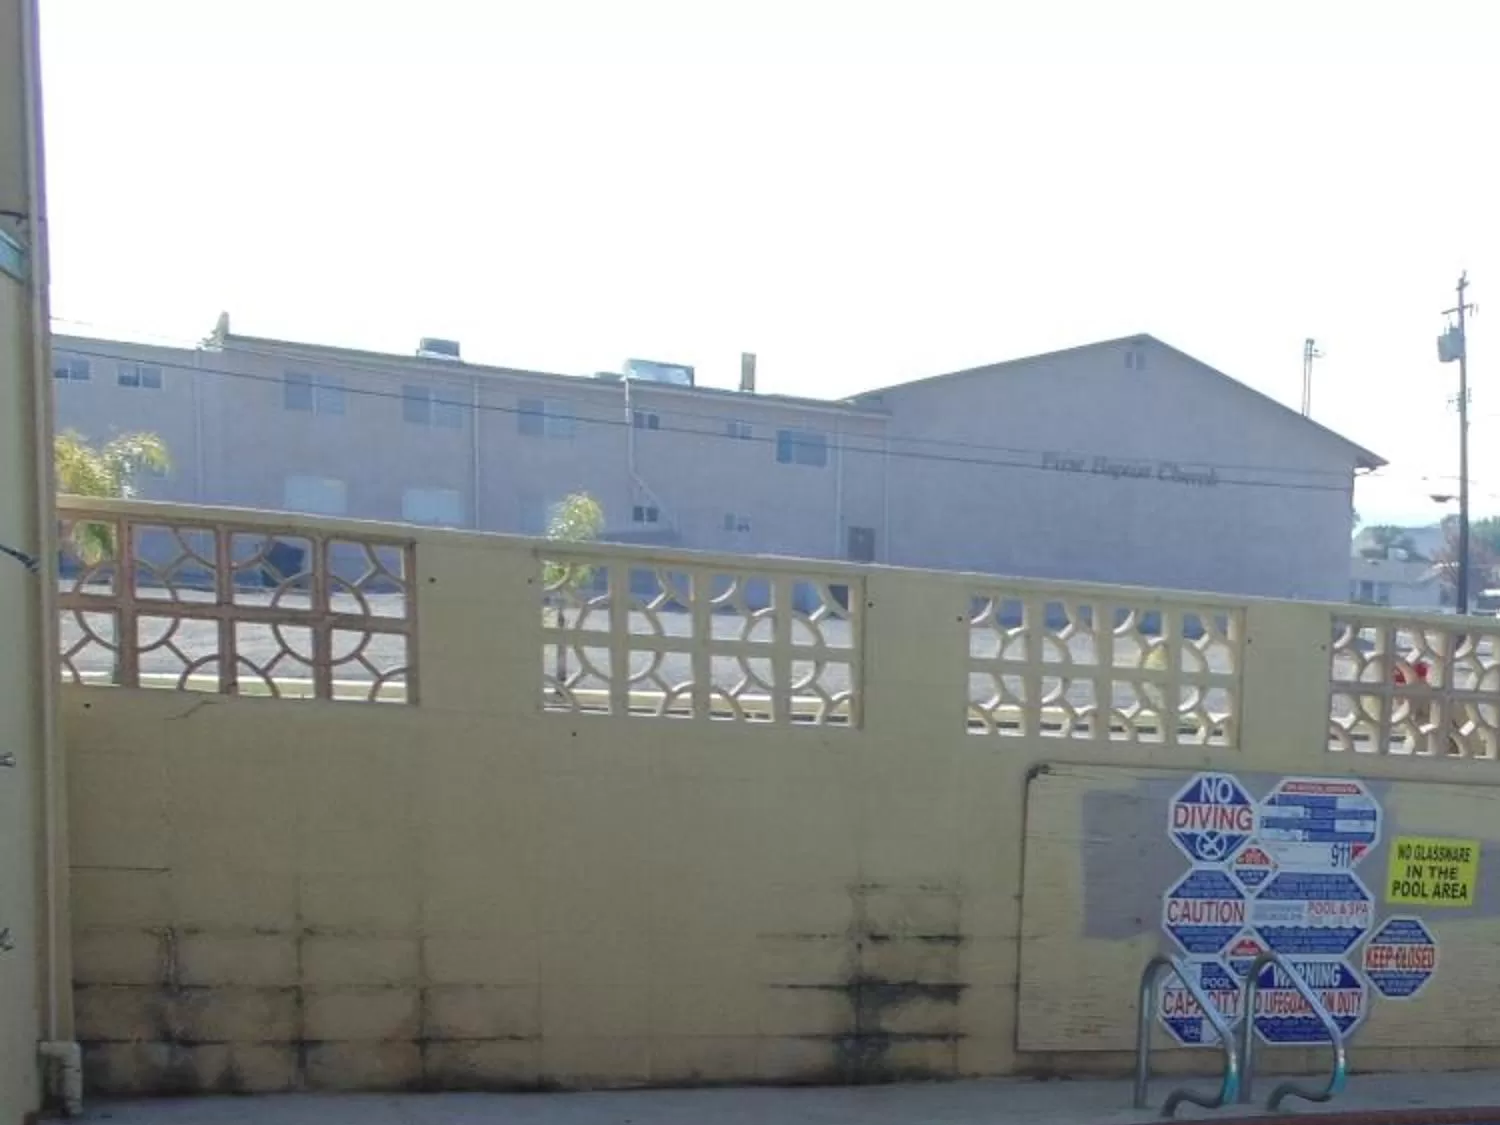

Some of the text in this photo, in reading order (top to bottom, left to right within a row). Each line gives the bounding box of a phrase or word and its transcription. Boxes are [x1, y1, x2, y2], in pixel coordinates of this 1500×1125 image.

[1200, 778, 1233, 803] NO
[1174, 804, 1253, 830] DIVING
[1331, 844, 1351, 868] 911
[1397, 844, 1471, 862] NO GLASSWARE
[1406, 865, 1457, 880] IN THE
[1392, 880, 1467, 899] POOL AREA
[1168, 901, 1245, 923] CAUTION
[1366, 946, 1434, 968] KEEP CLOSED
[1264, 992, 1318, 1012] LIFEGUA
